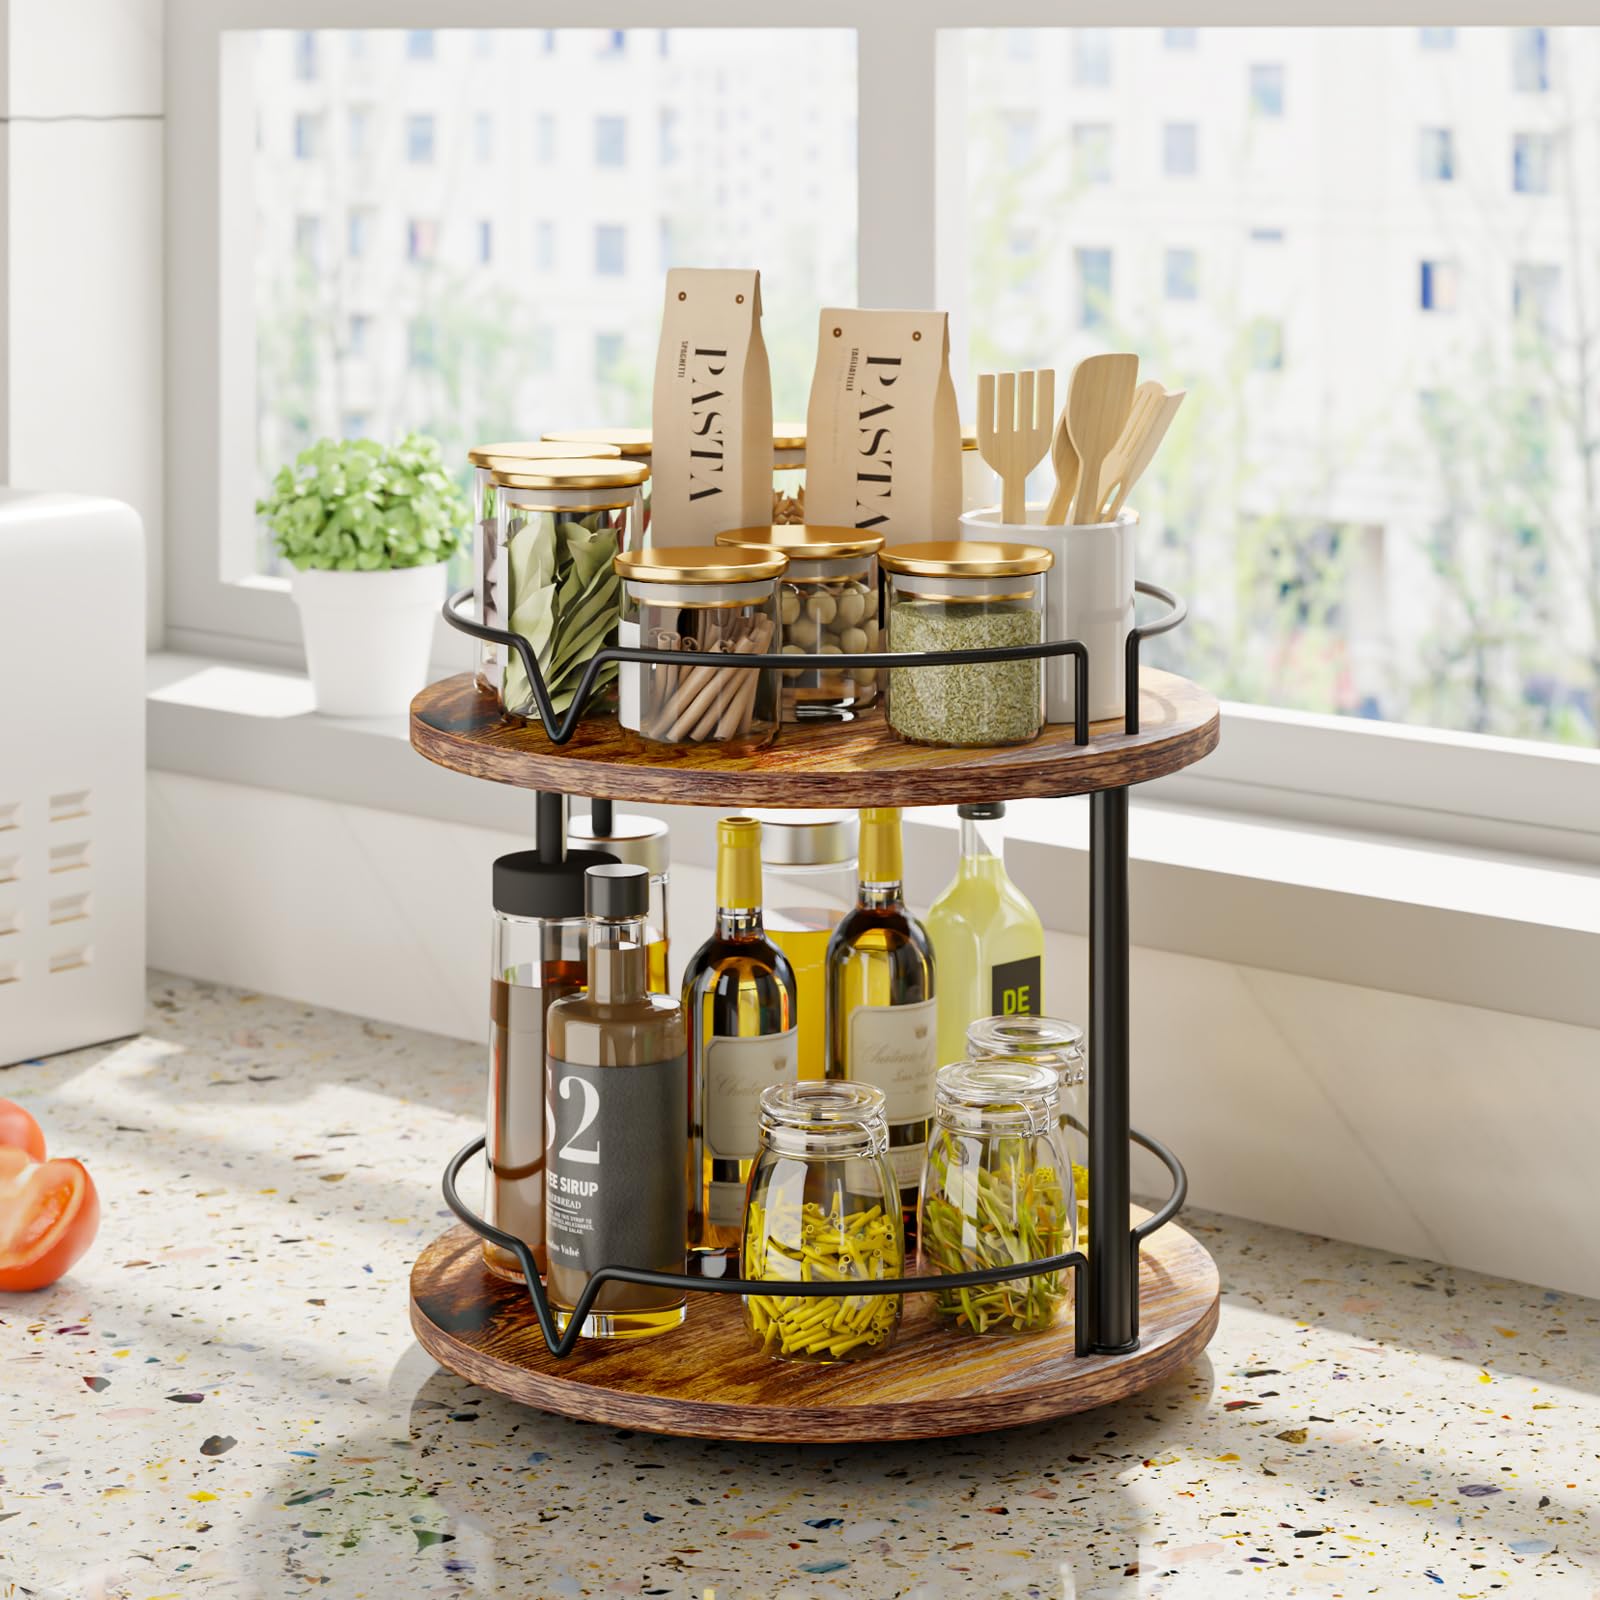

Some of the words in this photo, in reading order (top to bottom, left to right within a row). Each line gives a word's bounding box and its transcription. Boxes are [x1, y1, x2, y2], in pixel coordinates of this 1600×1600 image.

[689, 348, 728, 501] PASTA
[855, 356, 902, 528] PASTA
[1003, 986, 1031, 1017] DE
[560, 1177, 599, 1197] SIRUP
